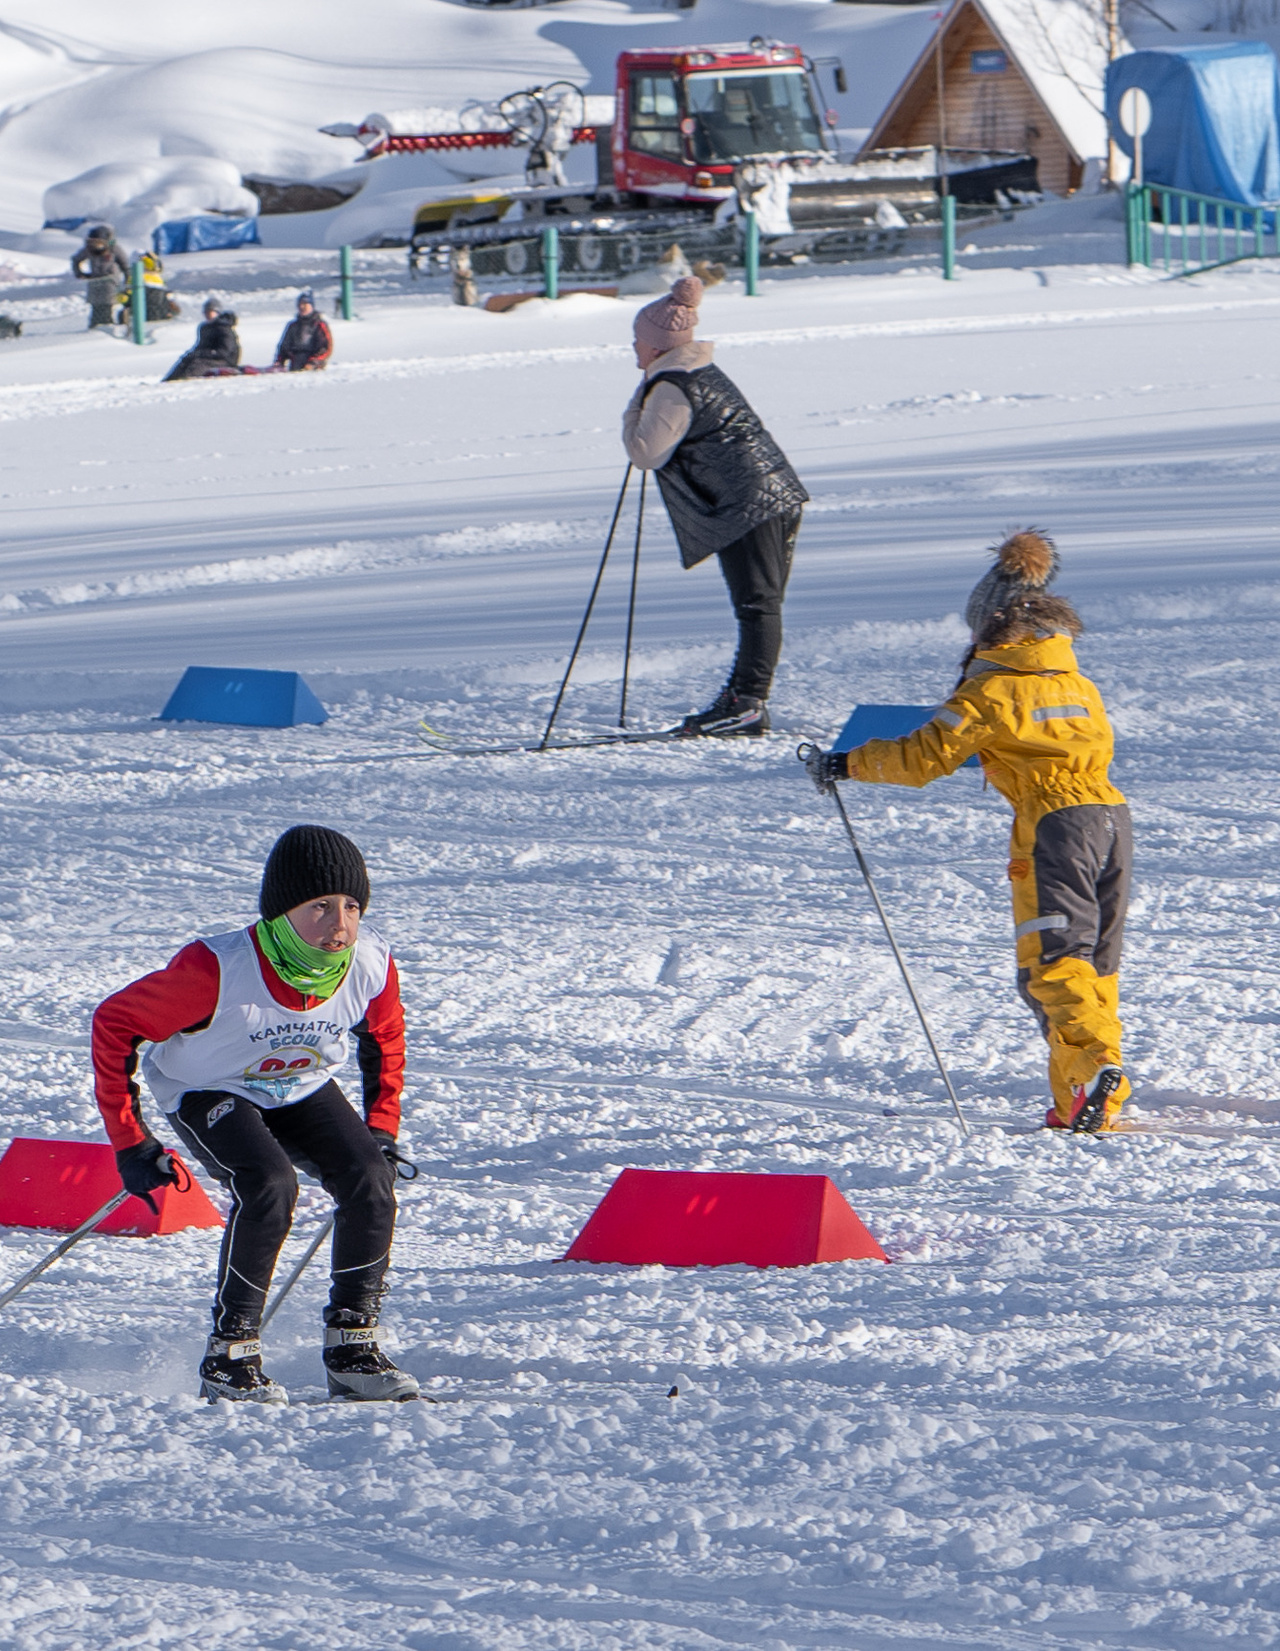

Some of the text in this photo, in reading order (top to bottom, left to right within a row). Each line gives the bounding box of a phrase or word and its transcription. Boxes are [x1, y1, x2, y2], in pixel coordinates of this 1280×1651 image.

[249, 1021, 344, 1043] КАМЧАТКА
[269, 1034, 321, 1051] БСОШ
[345, 1331, 374, 1341] TISA
